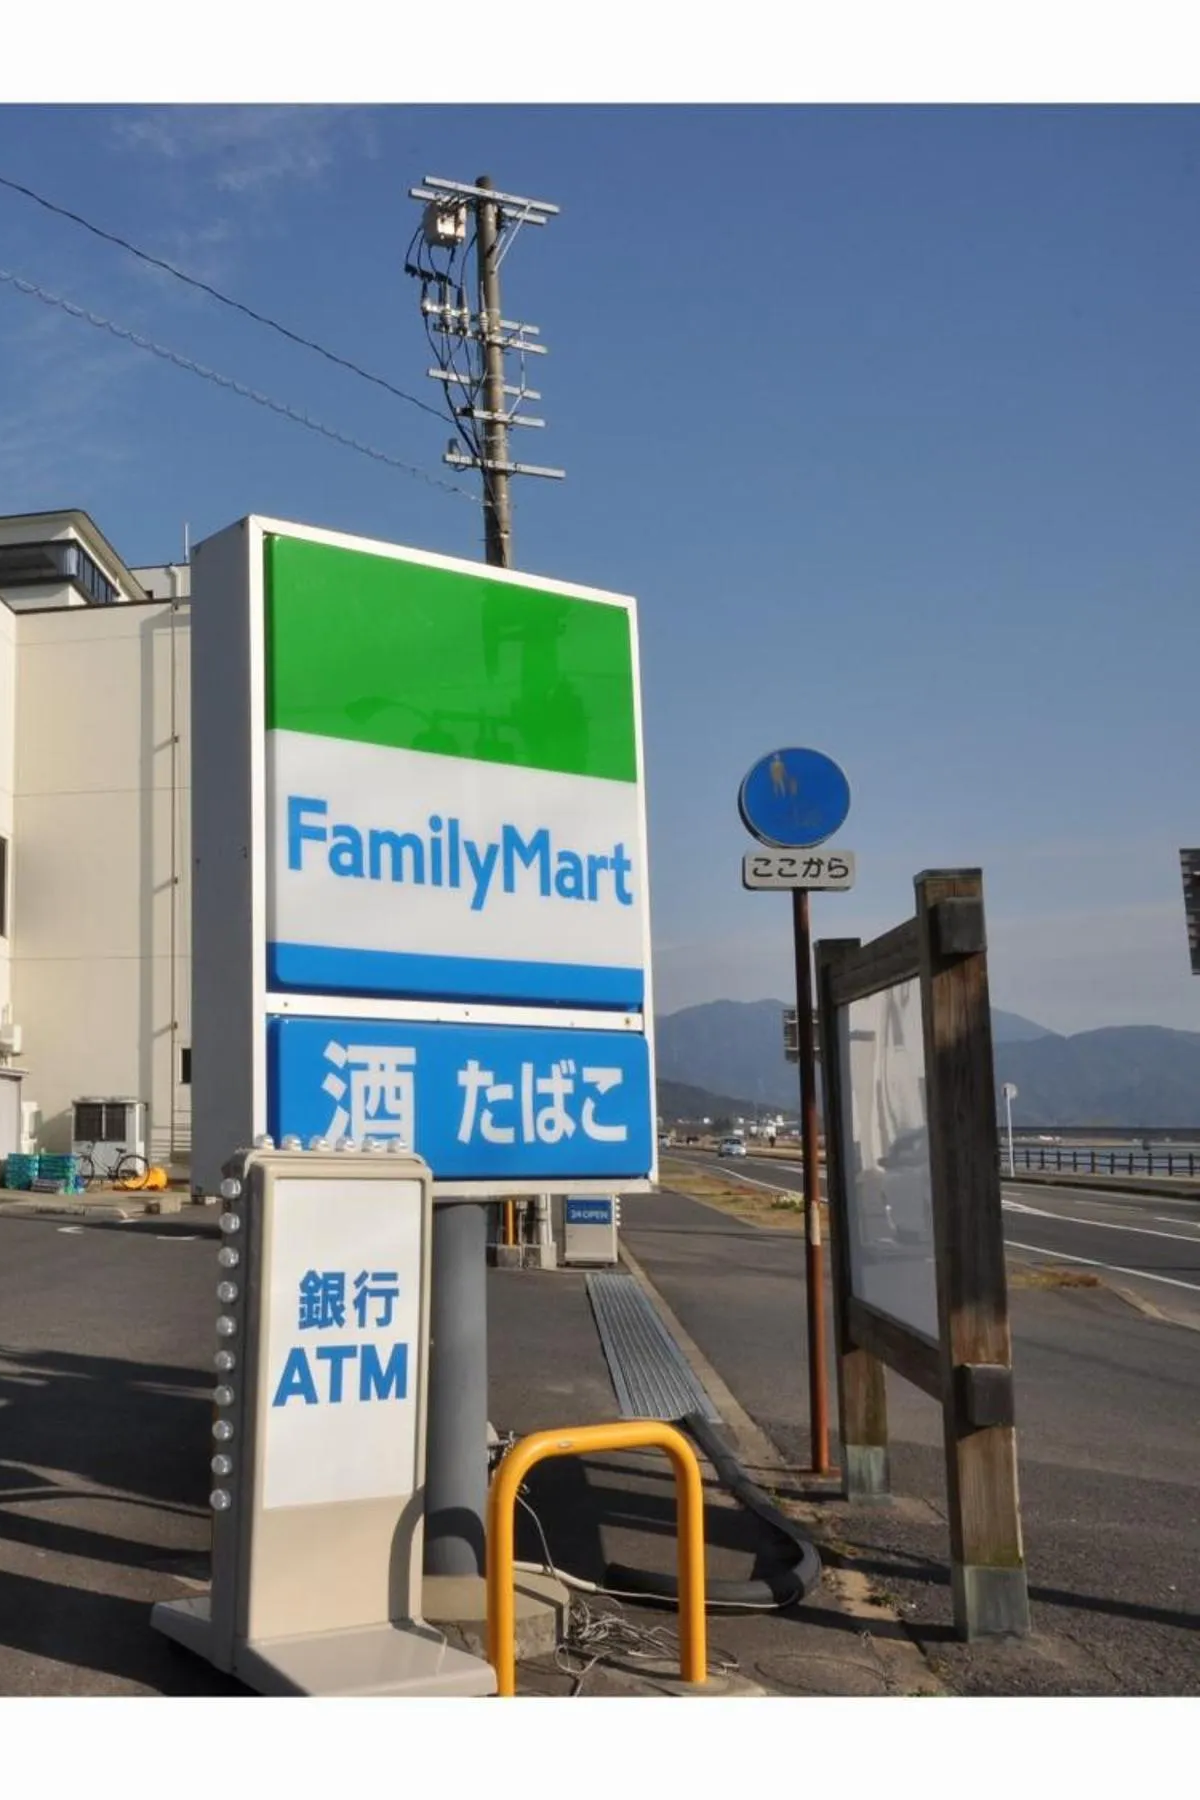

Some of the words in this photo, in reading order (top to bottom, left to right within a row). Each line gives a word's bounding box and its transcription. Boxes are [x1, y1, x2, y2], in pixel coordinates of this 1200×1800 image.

[287, 795, 634, 911] FamilyMart
[752, 857, 849, 878] ここから
[321, 1040, 416, 1153] 酒
[457, 1059, 628, 1145] たばこ
[298, 1270, 400, 1330] 銀行
[272, 1343, 408, 1407] ATM
